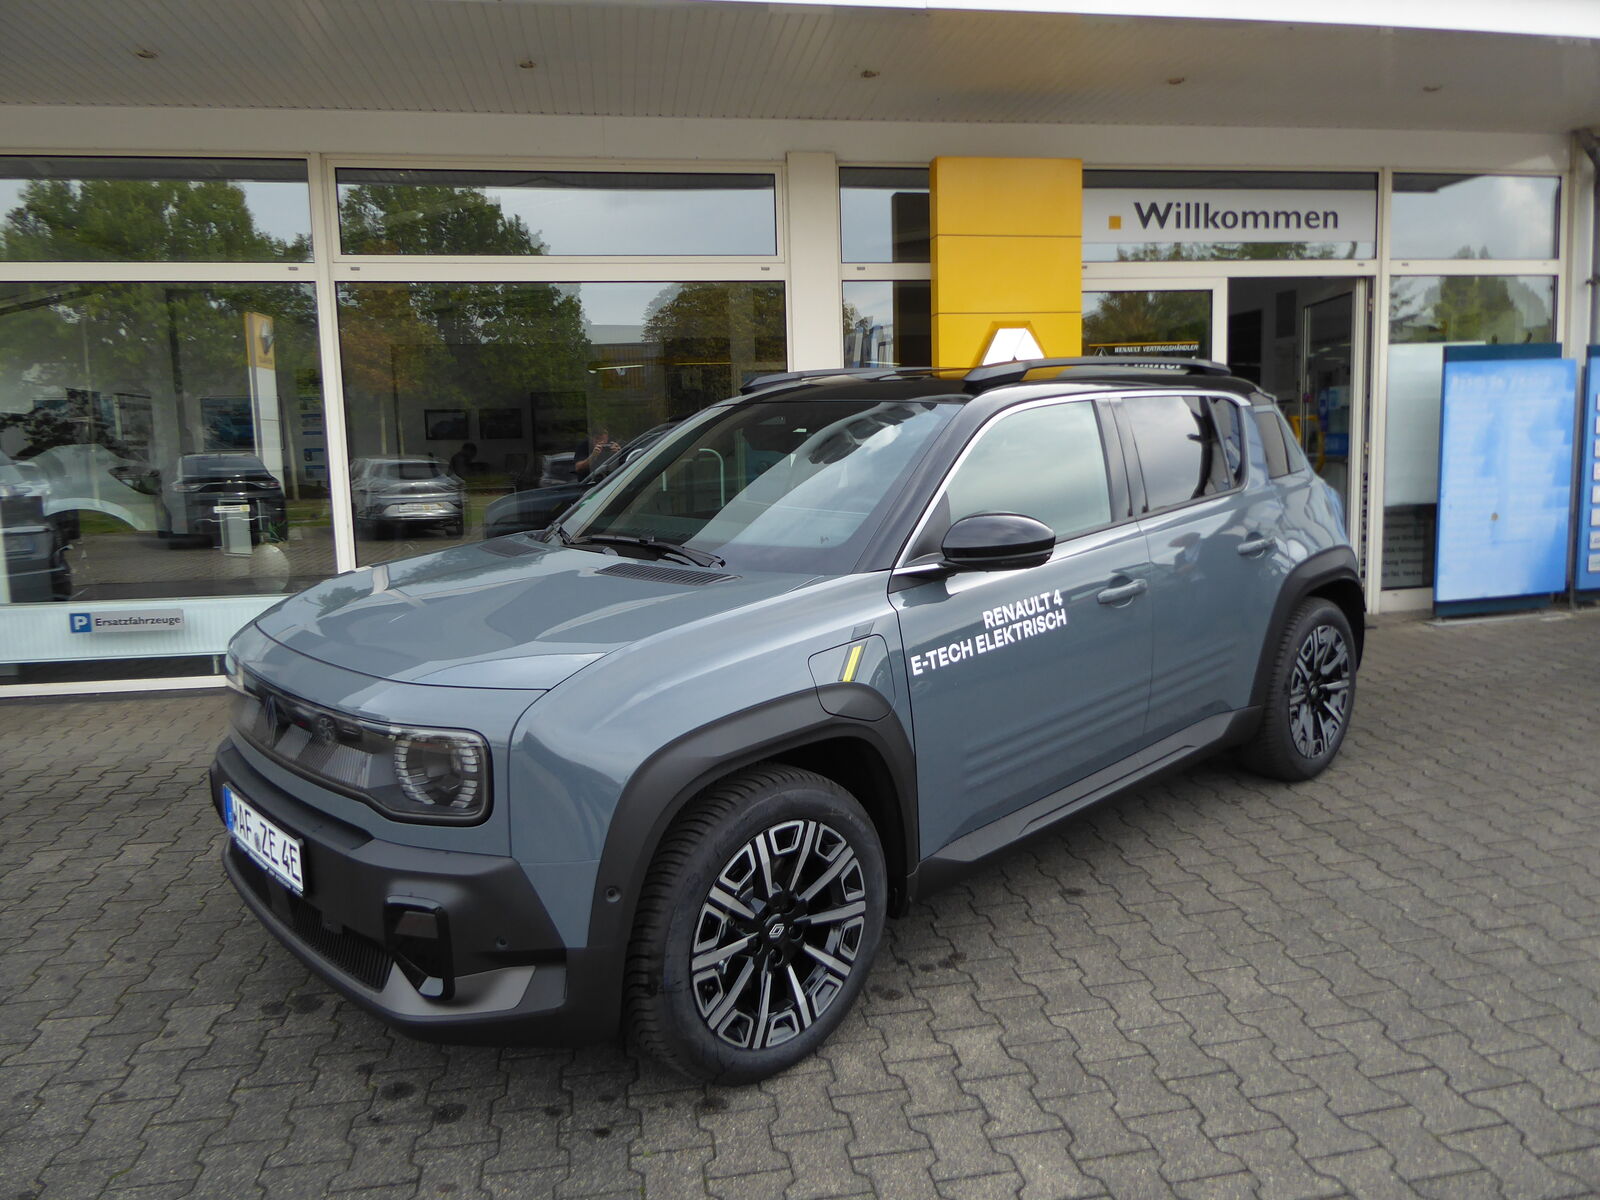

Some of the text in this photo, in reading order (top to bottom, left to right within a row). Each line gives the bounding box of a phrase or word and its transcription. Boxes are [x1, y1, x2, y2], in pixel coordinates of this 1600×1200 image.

[1133, 202, 1339, 229] Willkommen
[73, 616, 181, 630] P Ersatzfahrzeuge
[982, 589, 1063, 629] RENAULT 4
[910, 608, 1067, 676] E-TECH ELEKTRISCH
